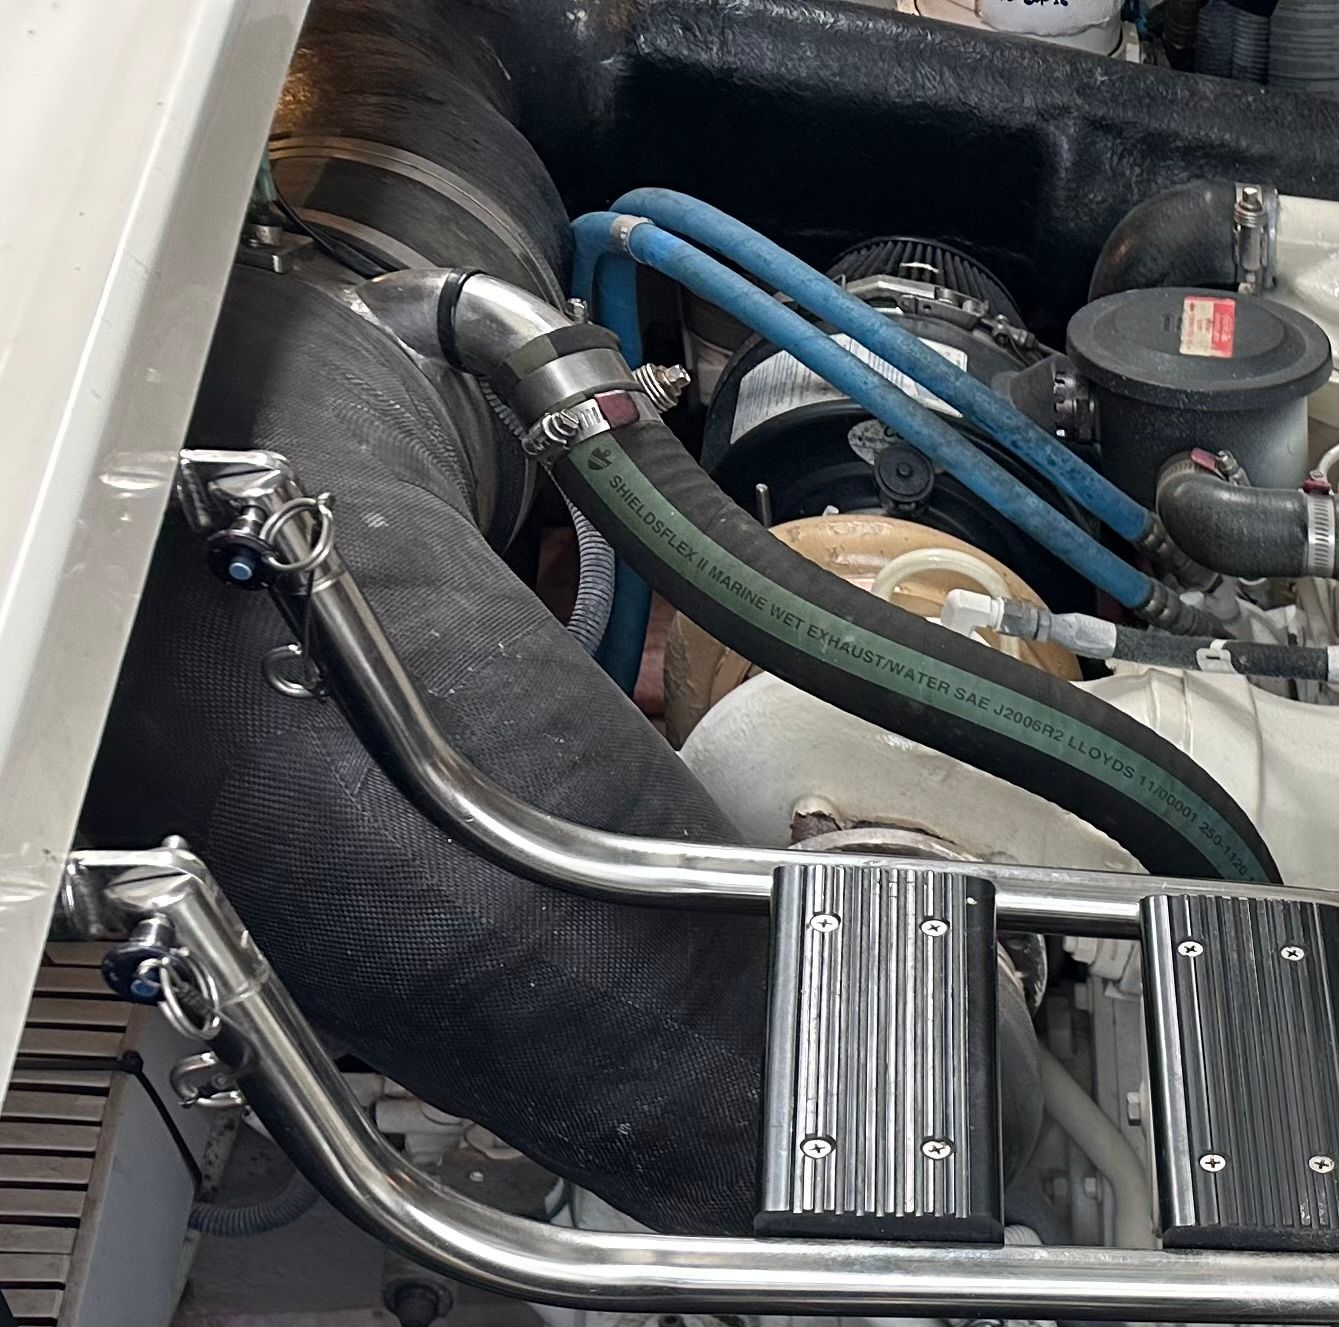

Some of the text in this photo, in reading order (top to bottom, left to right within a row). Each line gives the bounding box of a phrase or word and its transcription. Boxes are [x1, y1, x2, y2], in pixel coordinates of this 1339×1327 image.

[609, 474, 695, 563] SHIELDSFLEX
[697, 555, 709, 571] II
[708, 563, 767, 611] MARINE
[770, 602, 806, 632] WET
[806, 624, 949, 695] EXHAUST/WATER
[954, 686, 988, 711] SAE
[993, 700, 1064, 743] J2006R2
[1067, 734, 1135, 779] LLOYDS
[1138, 773, 1197, 824] 11/00001
